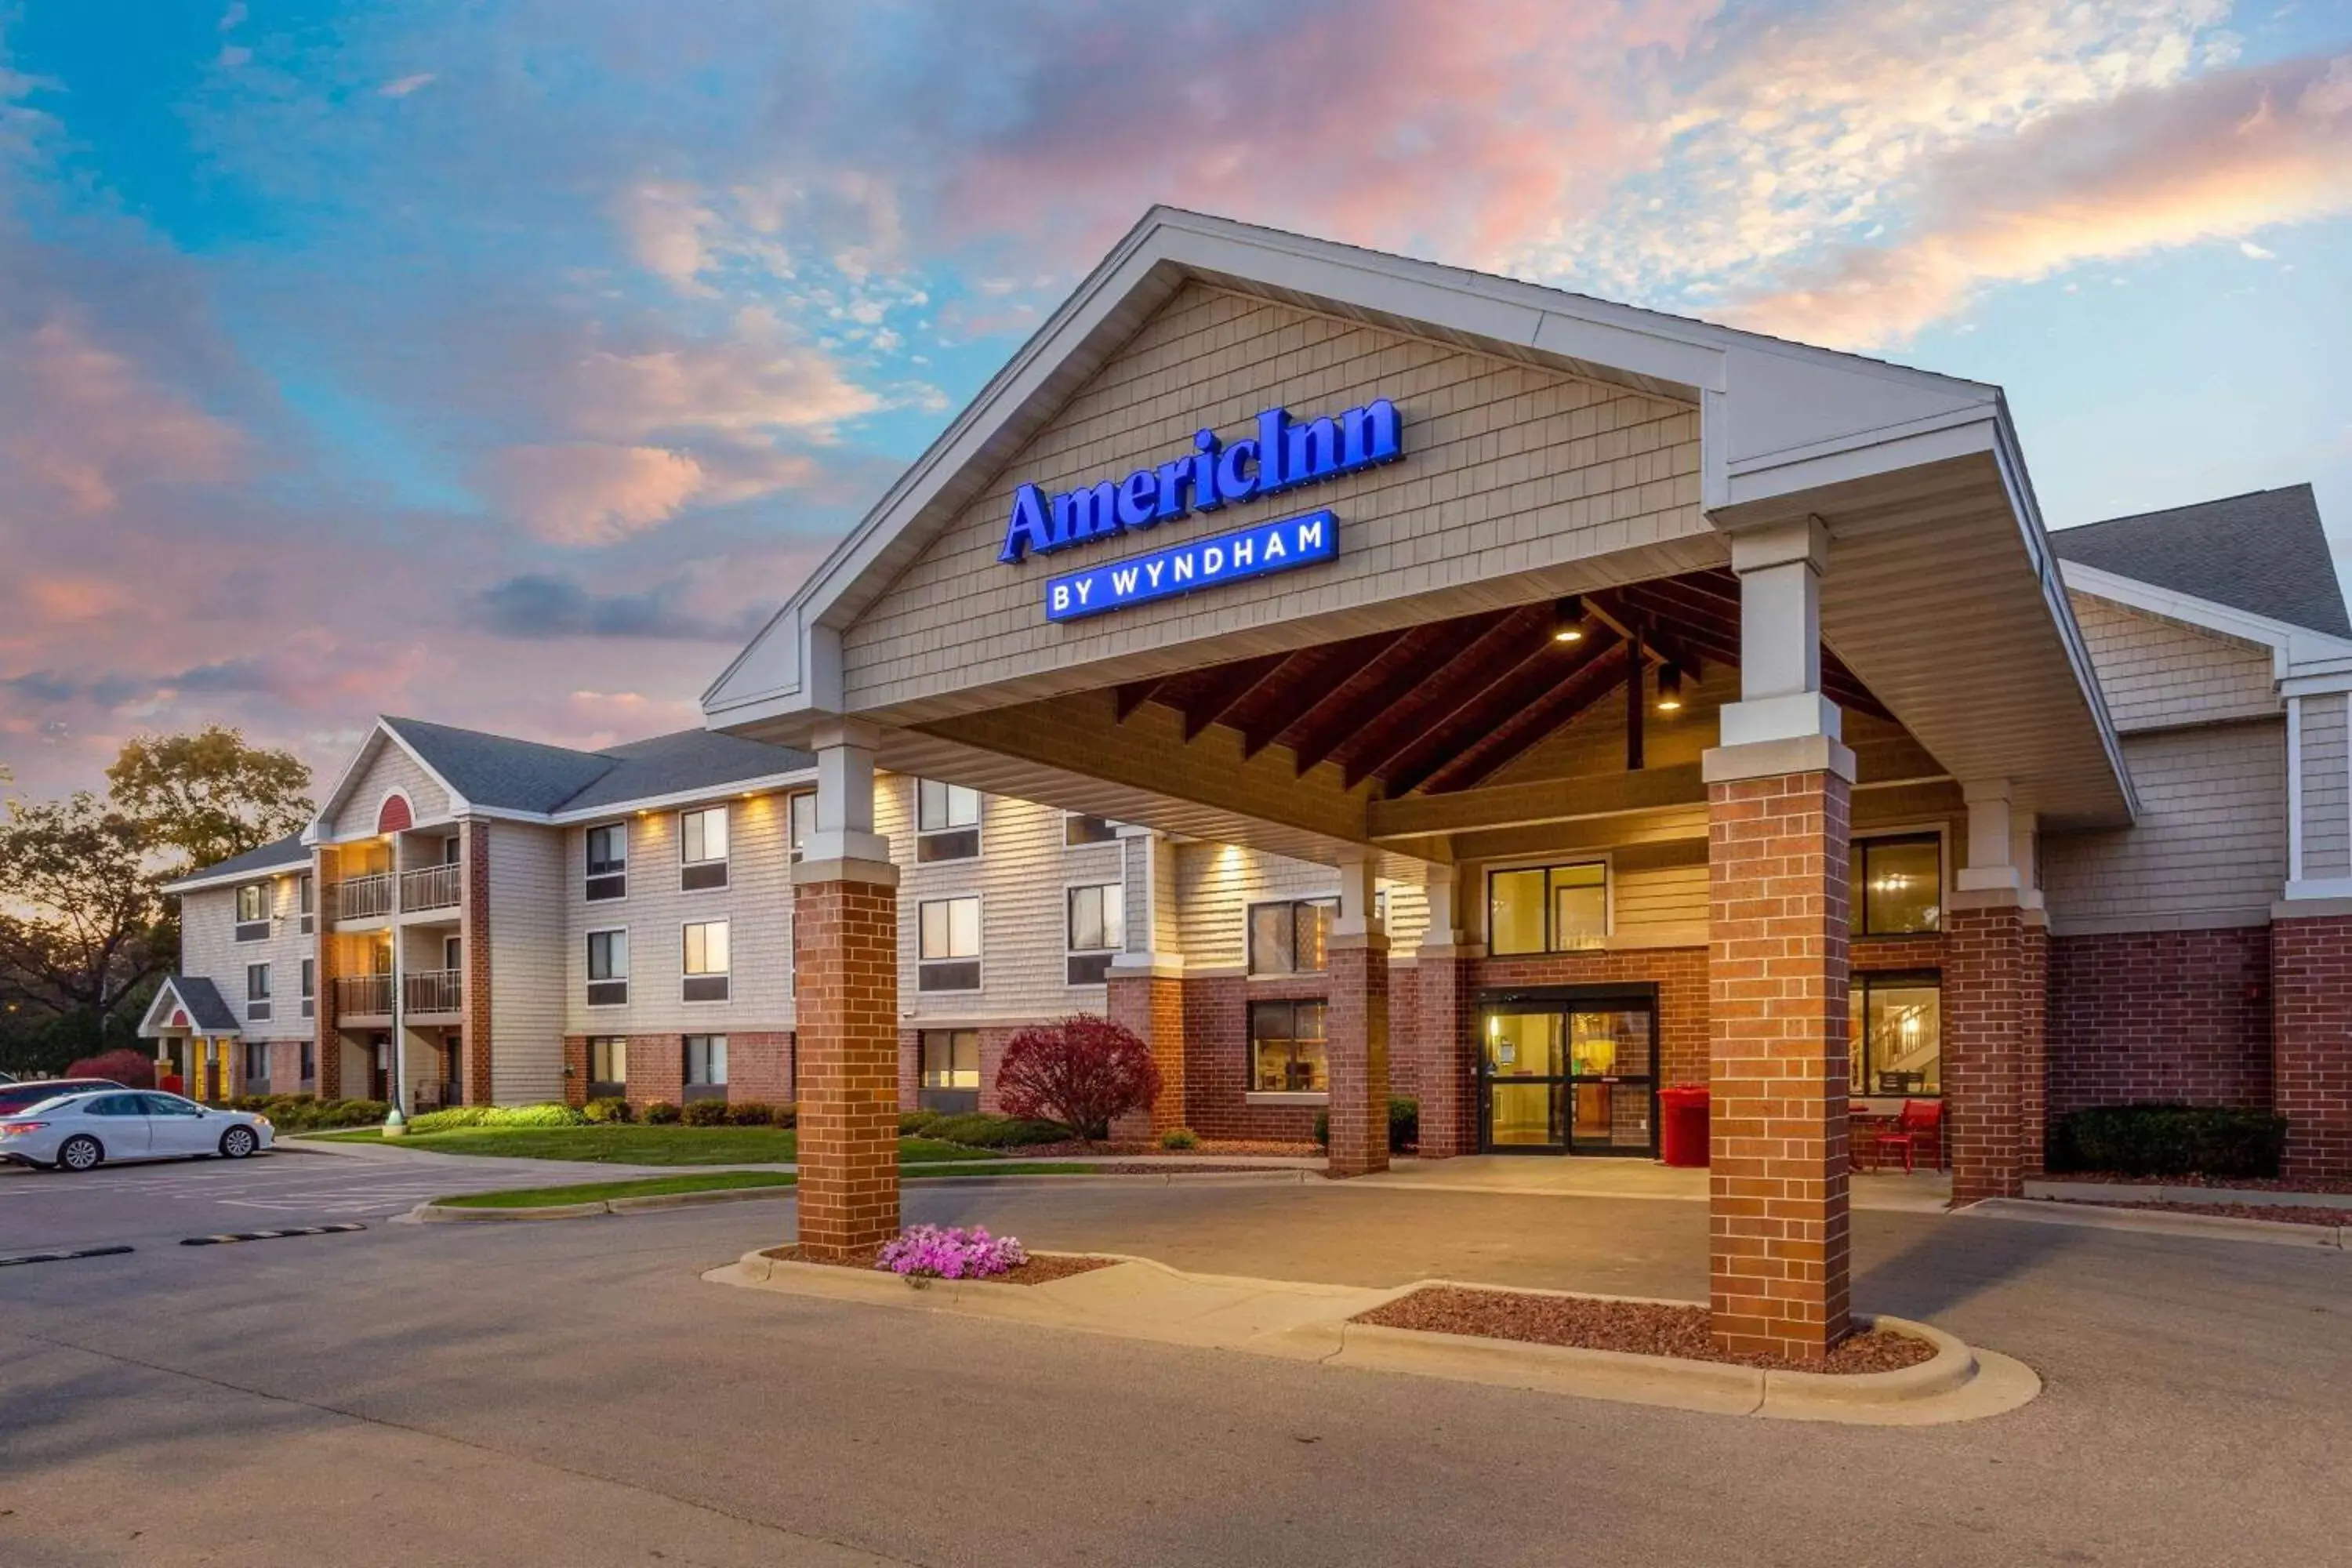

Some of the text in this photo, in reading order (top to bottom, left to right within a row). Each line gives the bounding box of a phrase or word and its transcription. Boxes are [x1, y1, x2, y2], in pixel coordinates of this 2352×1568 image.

[997, 398, 1403, 563] AmericInn
[1052, 520, 1323, 612] BY WYNDHAM
